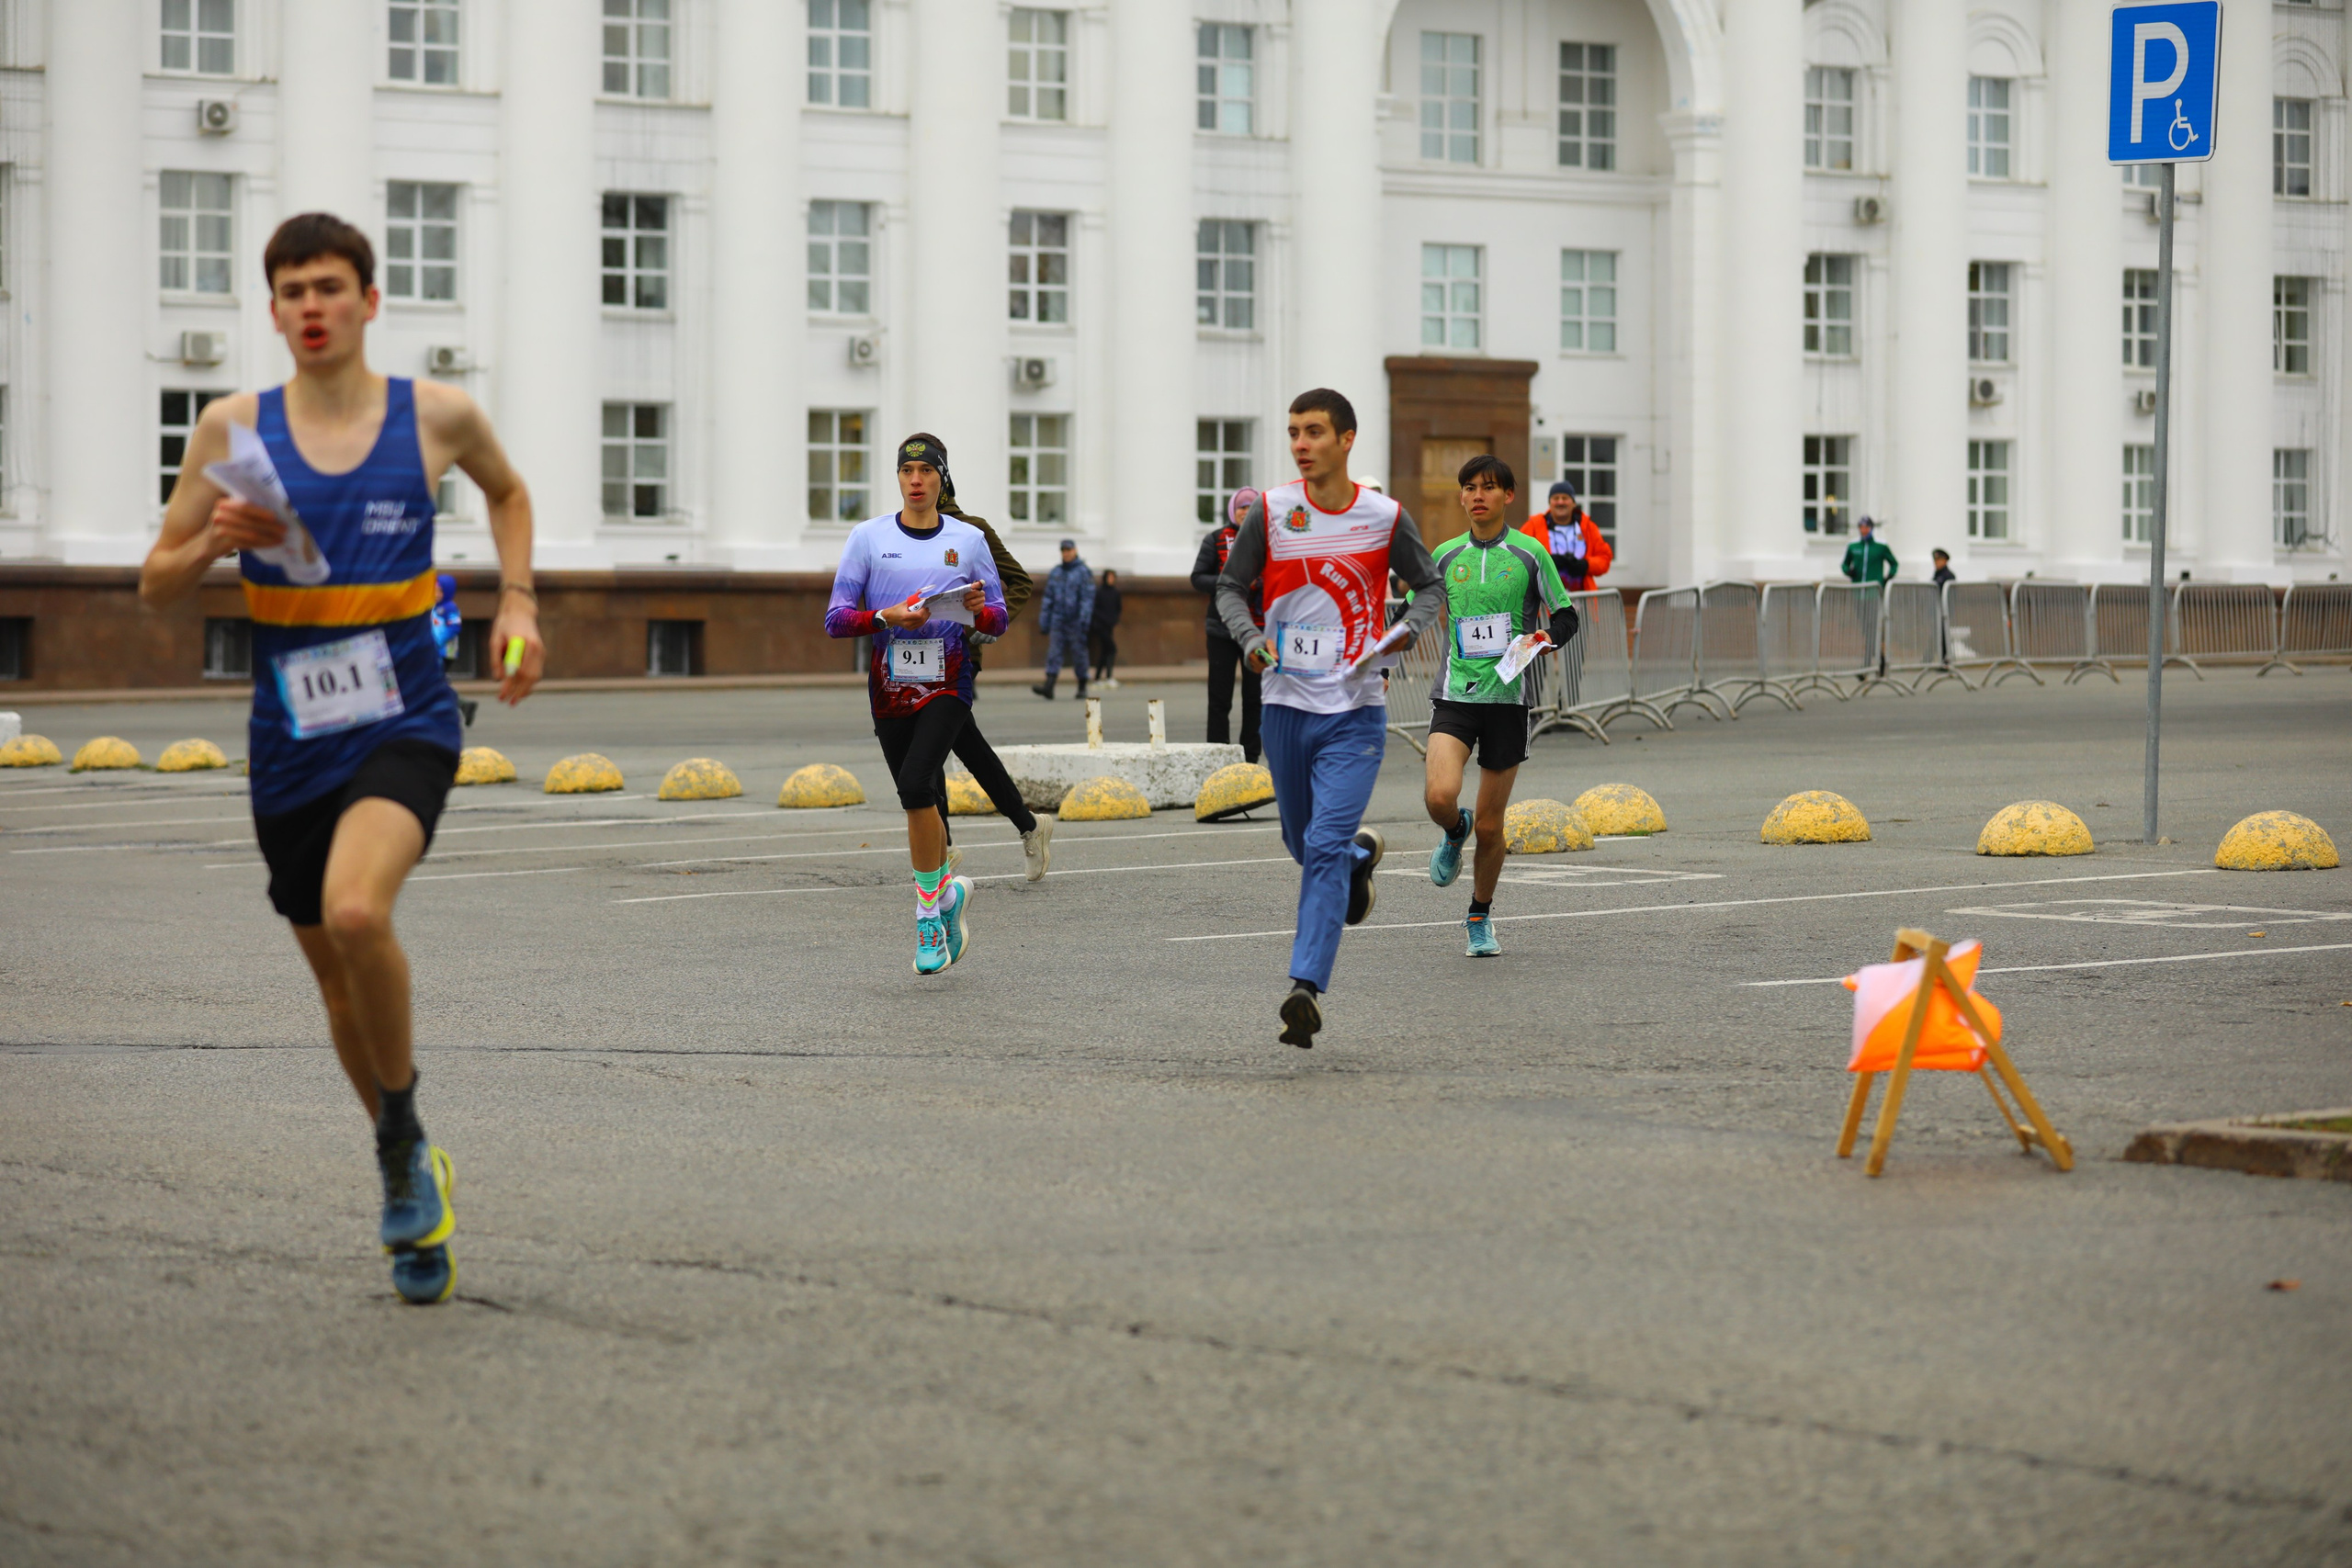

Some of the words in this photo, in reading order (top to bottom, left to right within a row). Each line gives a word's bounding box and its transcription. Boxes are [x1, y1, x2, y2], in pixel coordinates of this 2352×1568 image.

[2131, 21, 2189, 144] P
[1319, 561, 1349, 590] Run
[1345, 589, 1363, 615] and
[1294, 637, 1319, 656] 8.1
[1346, 617, 1366, 655] think
[1472, 626, 1495, 640] 4.1
[902, 649, 926, 665] 9.1
[302, 662, 364, 701] 10.1
